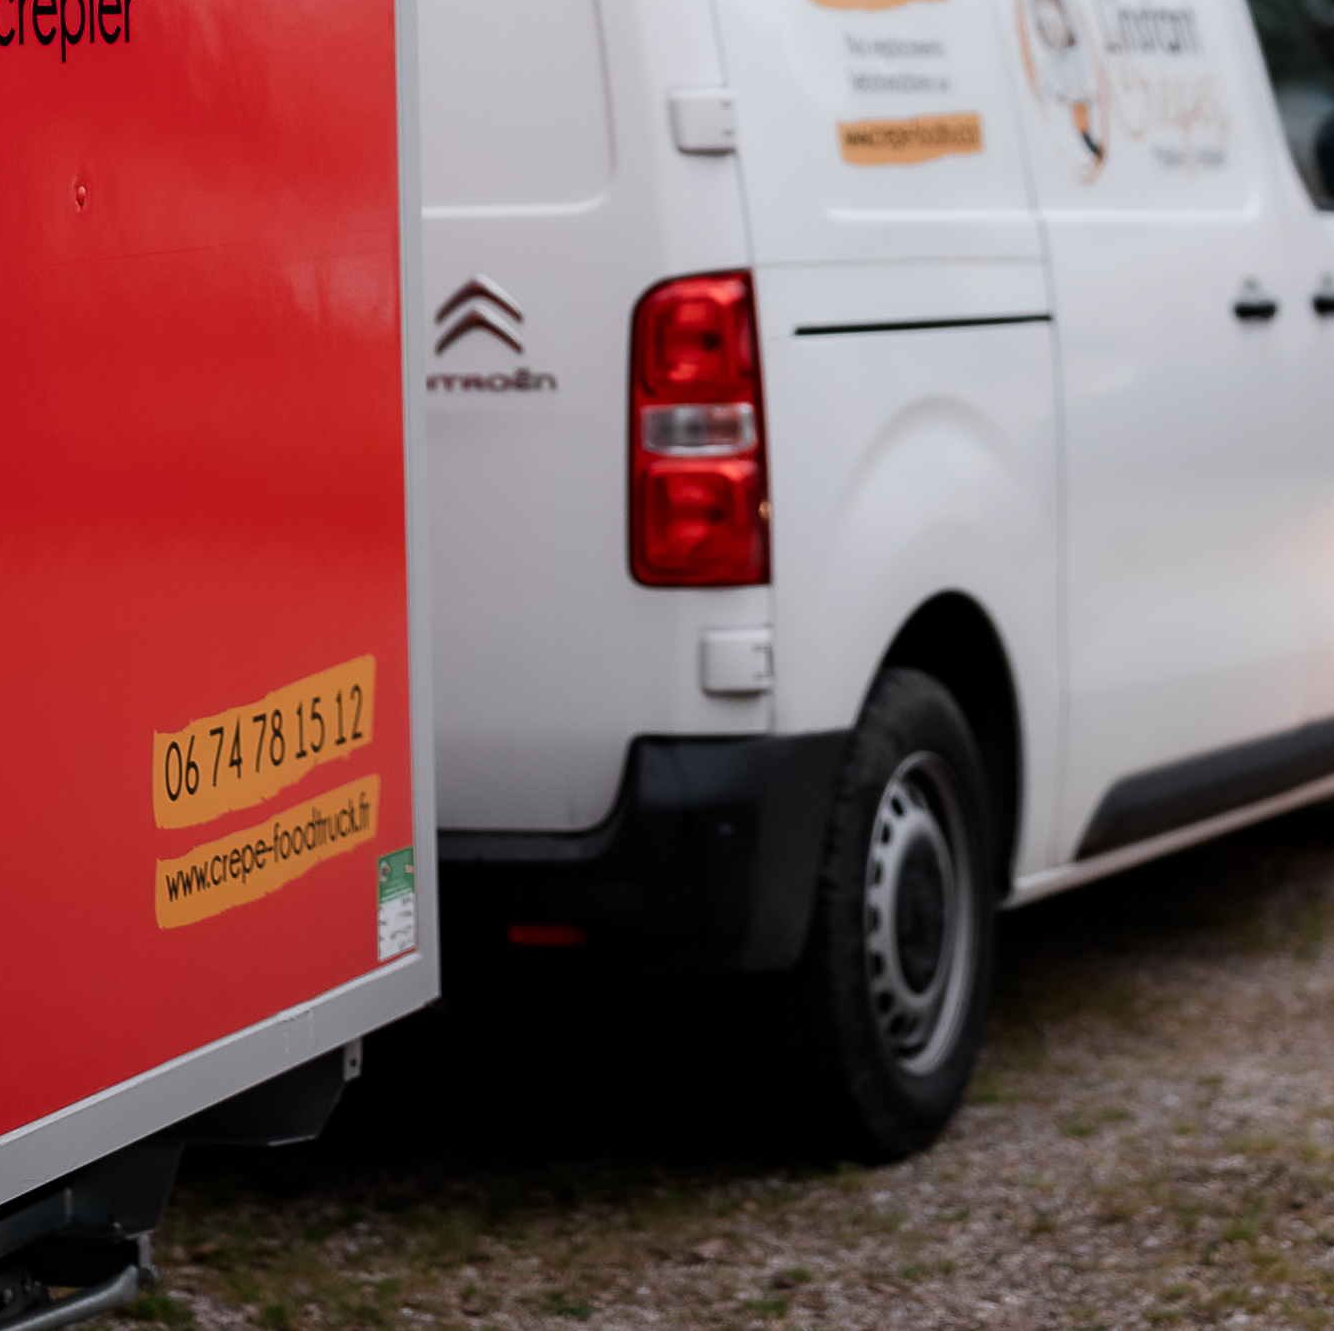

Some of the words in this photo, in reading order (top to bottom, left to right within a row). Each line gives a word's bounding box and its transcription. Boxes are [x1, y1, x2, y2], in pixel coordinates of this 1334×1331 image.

[425, 367, 558, 391] ITROËN
[164, 734, 200, 801] 06
[209, 716, 243, 788] 74
[252, 708, 286, 774] 78
[294, 696, 326, 759] 15
[334, 683, 364, 747] 12
[165, 790, 371, 902] www.crepe-foodtruck.fr
